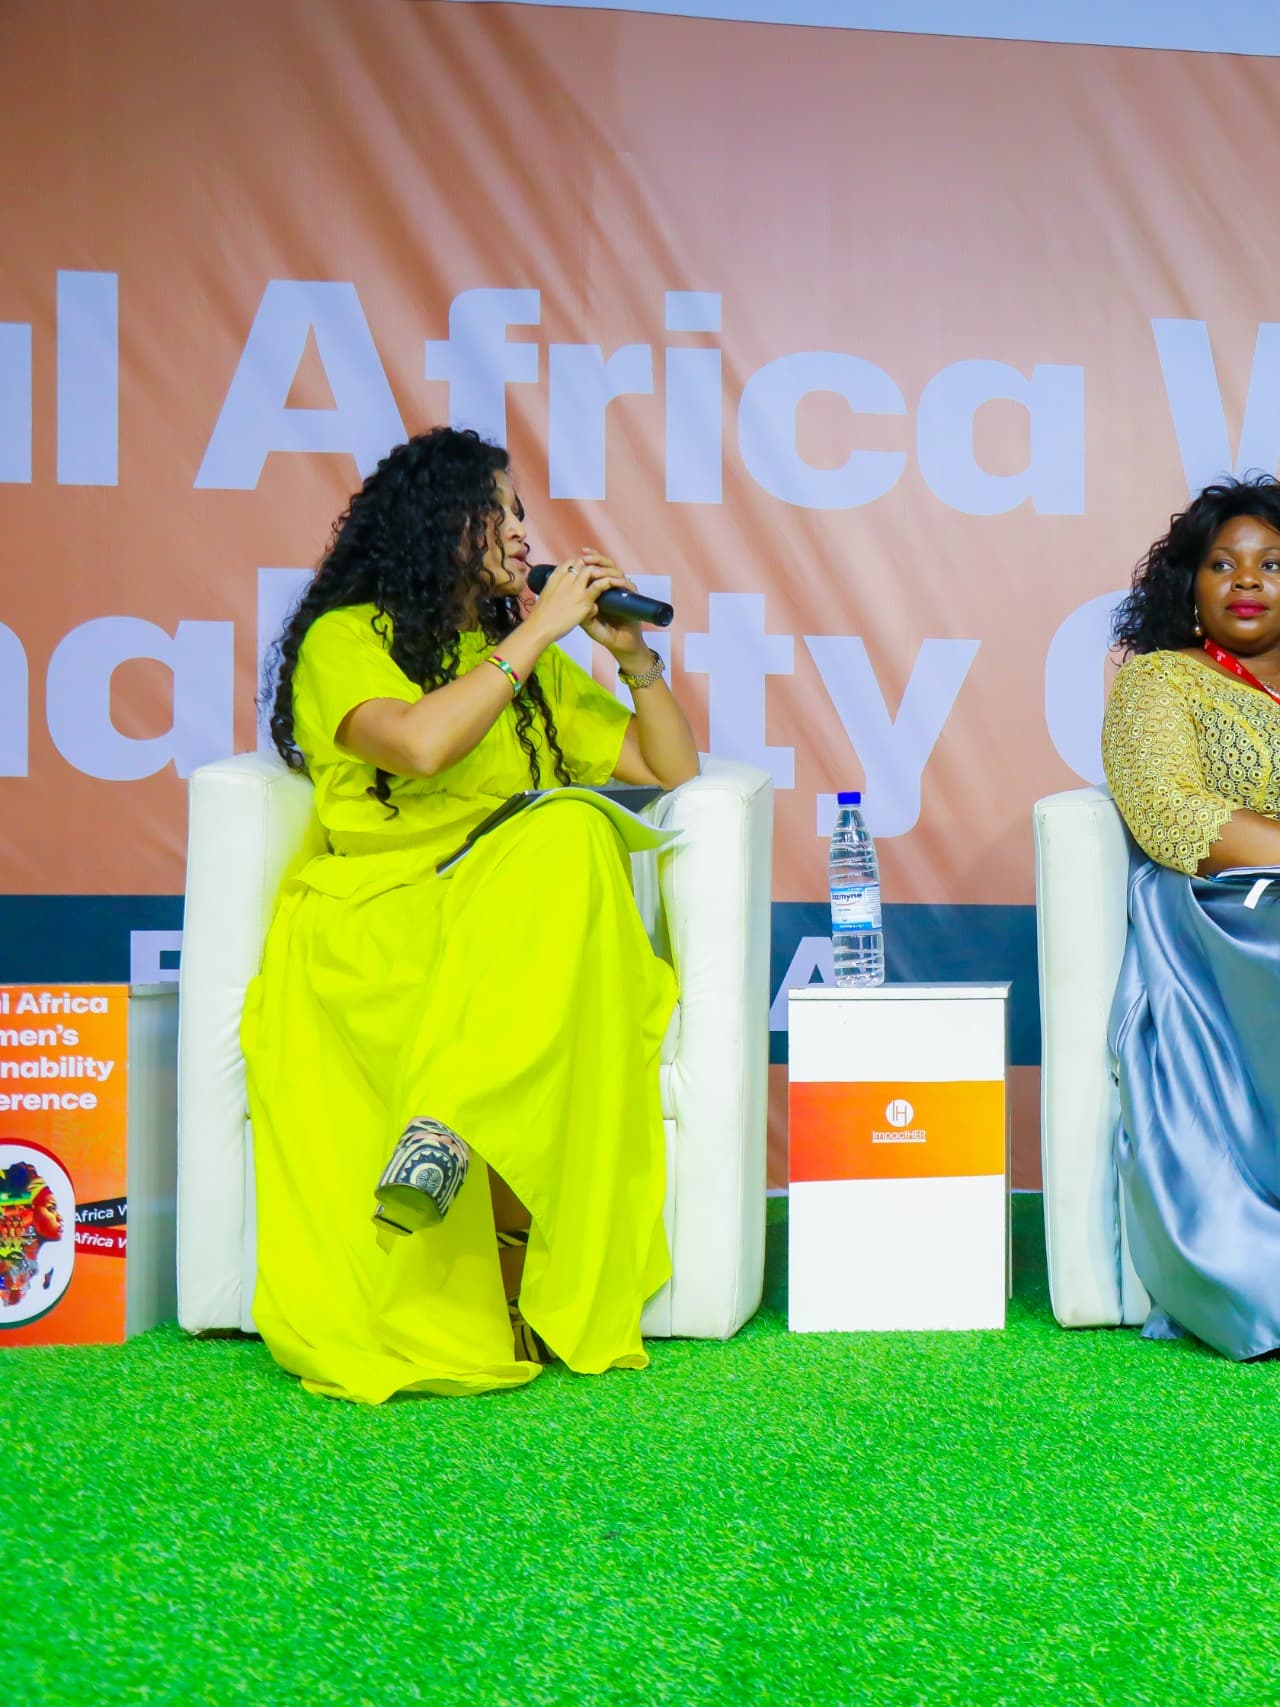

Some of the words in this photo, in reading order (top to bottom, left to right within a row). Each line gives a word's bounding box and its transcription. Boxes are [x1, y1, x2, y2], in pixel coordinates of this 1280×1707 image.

[193, 279, 1085, 515] Africa
[16, 992, 108, 1015] Africa
[872, 1129, 927, 1141] ImpactHER
[75, 1207, 114, 1223] Africa
[75, 1231, 114, 1248] Africa
